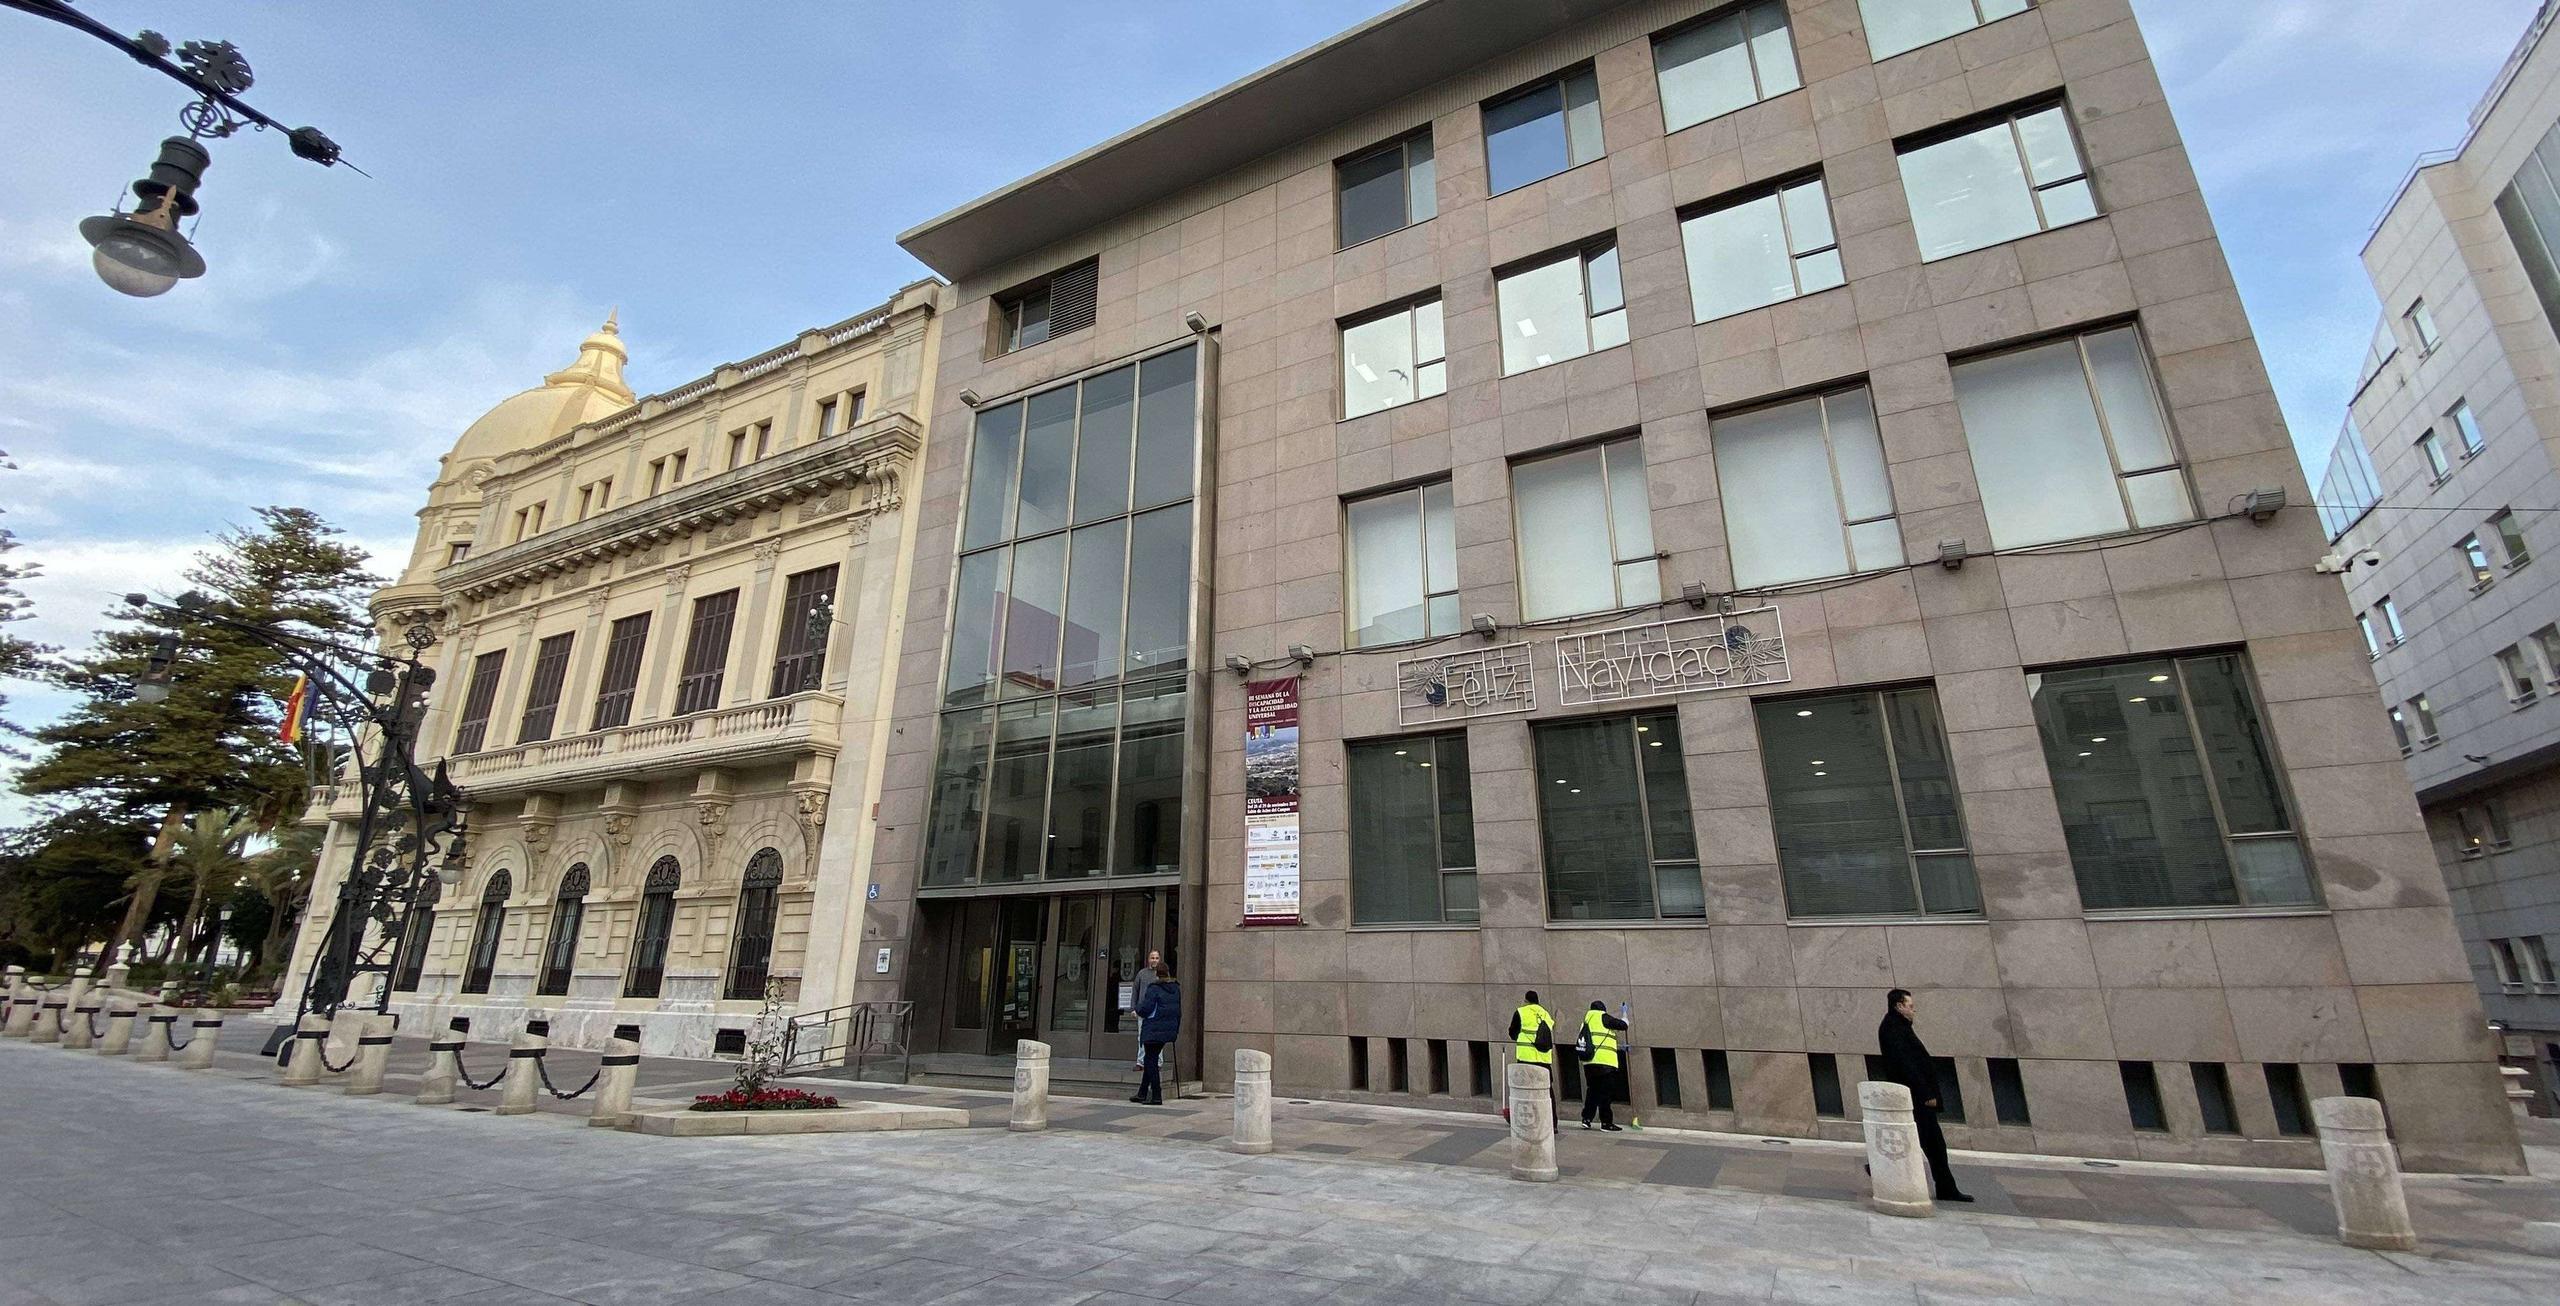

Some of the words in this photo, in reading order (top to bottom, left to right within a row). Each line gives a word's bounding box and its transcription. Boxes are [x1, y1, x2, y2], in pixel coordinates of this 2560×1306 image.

[1444, 651, 1517, 707] Feliz
[1561, 616, 1734, 692] Navidad
[1260, 703, 1297, 711] ACCESIBILIDAD
